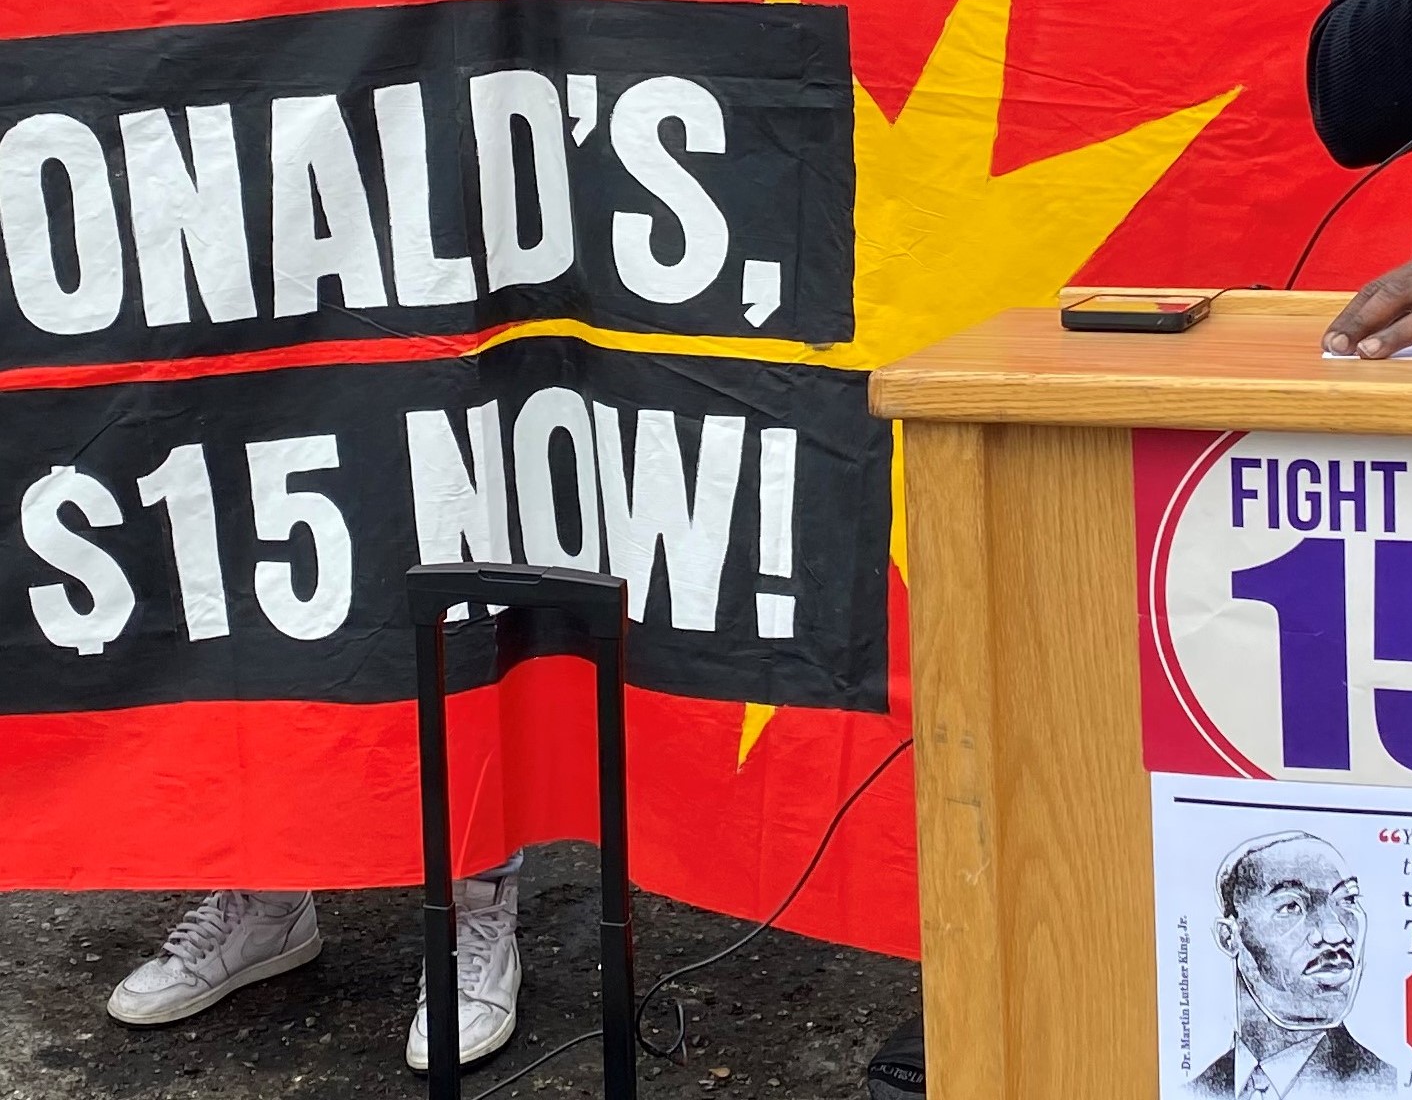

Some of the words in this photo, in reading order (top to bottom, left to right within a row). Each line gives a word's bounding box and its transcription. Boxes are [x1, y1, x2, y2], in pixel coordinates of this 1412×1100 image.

[0, 69, 782, 327] ONALD'S,
[20, 433, 353, 655] $15
[405, 386, 798, 640] NOW!
[1230, 457, 1408, 533] FIGHT
[1179, 966, 1190, 1006] Luther
[1180, 1009, 1190, 1050] Martin
